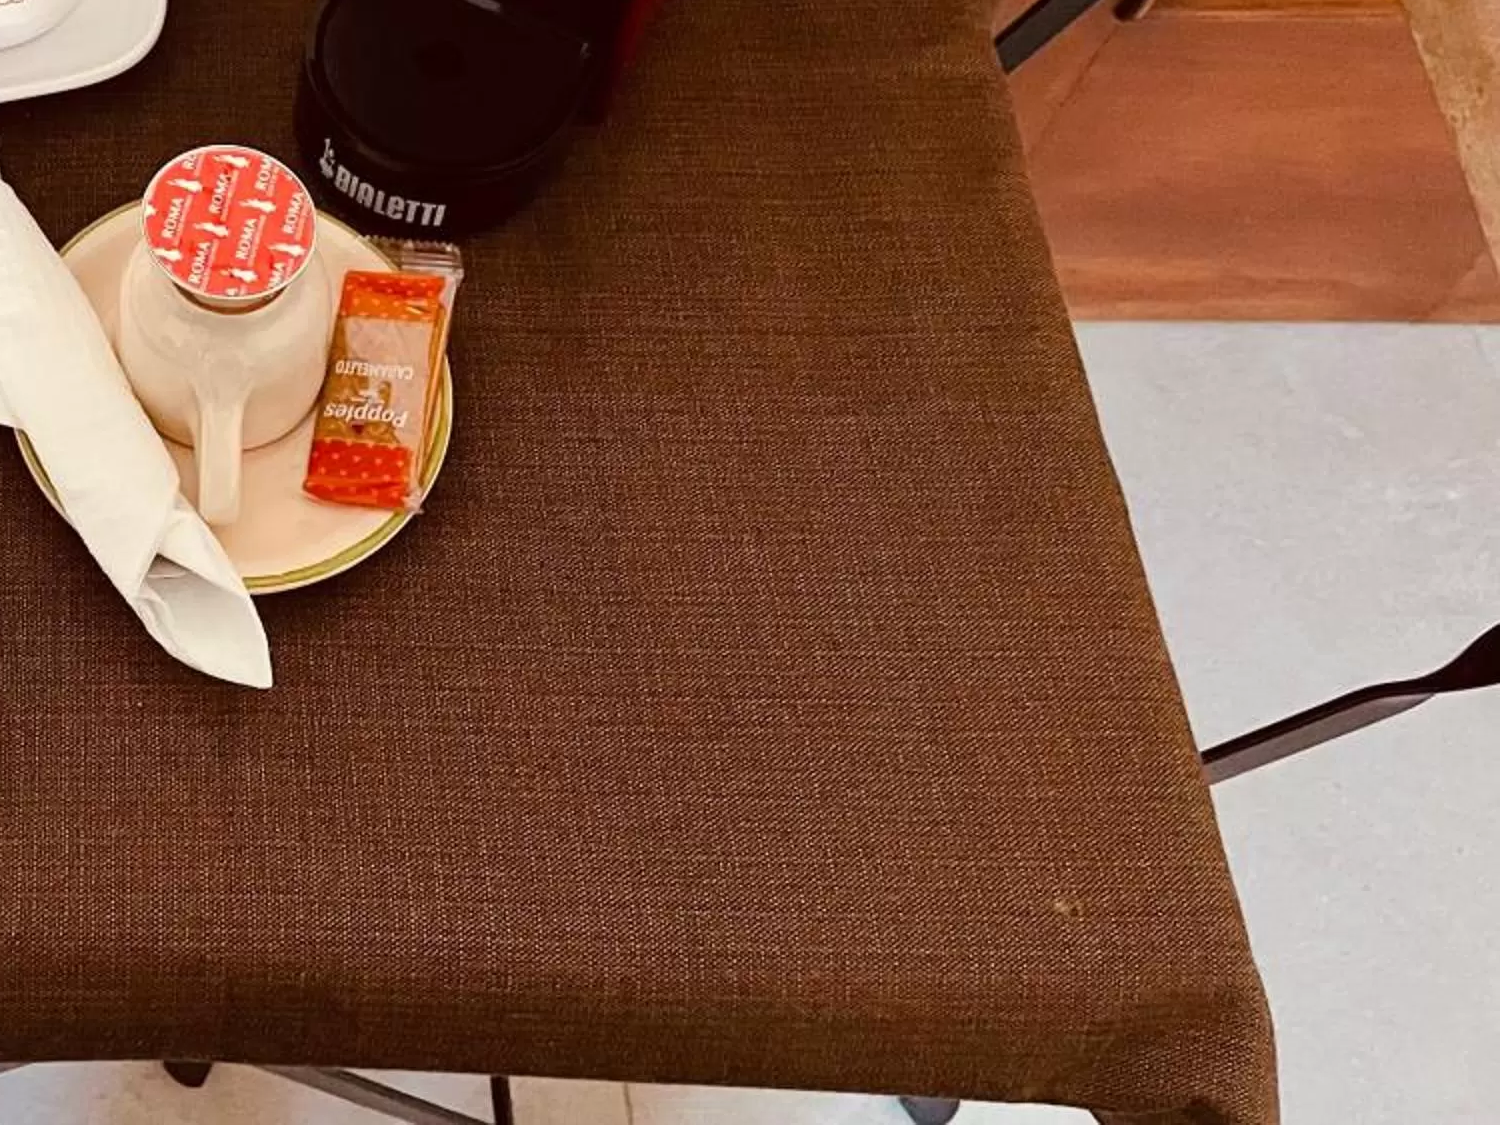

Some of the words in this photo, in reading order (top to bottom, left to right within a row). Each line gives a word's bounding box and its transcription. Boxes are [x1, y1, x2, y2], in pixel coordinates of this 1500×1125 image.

[208, 173, 234, 215] ROMA
[282, 191, 306, 235] ROMA
[161, 197, 185, 239] ROMA
[235, 218, 259, 260] ROMA
[188, 241, 212, 285] ROMA
[323, 401, 409, 428] Poppies
